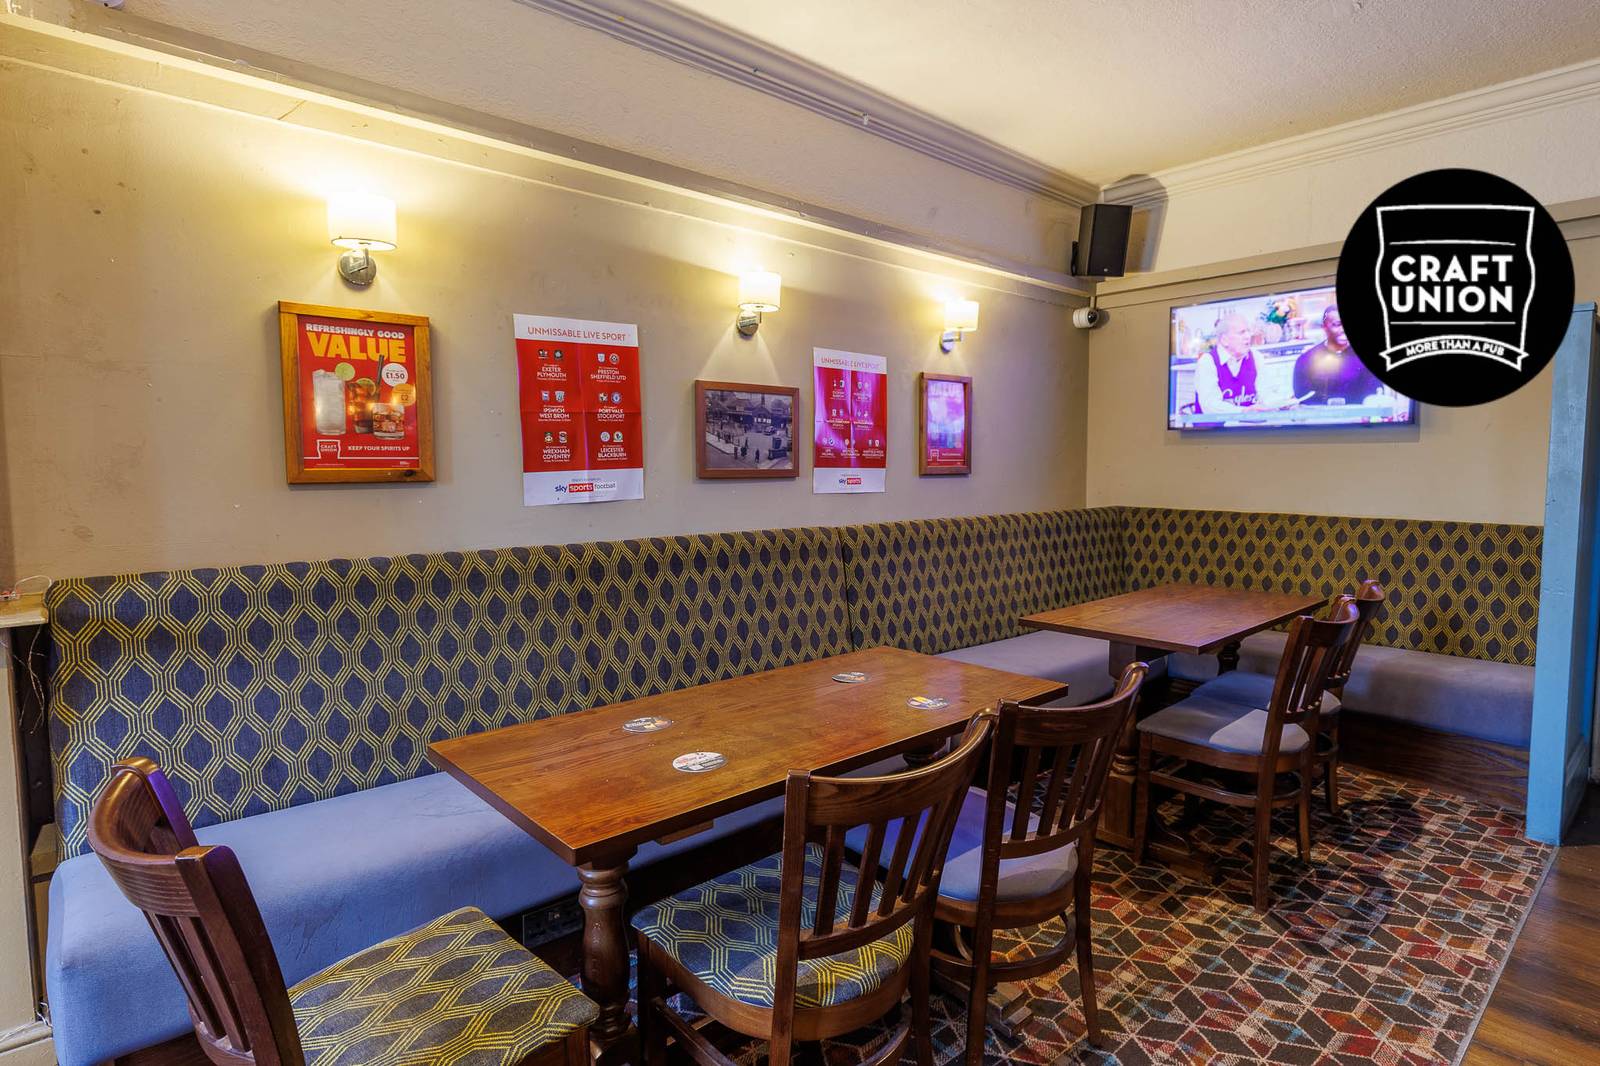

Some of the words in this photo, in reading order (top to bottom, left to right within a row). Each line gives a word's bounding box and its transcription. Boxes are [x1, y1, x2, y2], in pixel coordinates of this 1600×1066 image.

[305, 323, 374, 337] REFRESHINGLY
[377, 330, 405, 339] GOOD
[527, 326, 581, 338] UNMISSABLE
[583, 331, 601, 339] LIVE
[601, 332, 626, 341] SPORT
[306, 331, 406, 363] VALUE
[554, 484, 568, 493] sky
[569, 483, 593, 492] sports
[594, 482, 616, 491] football
